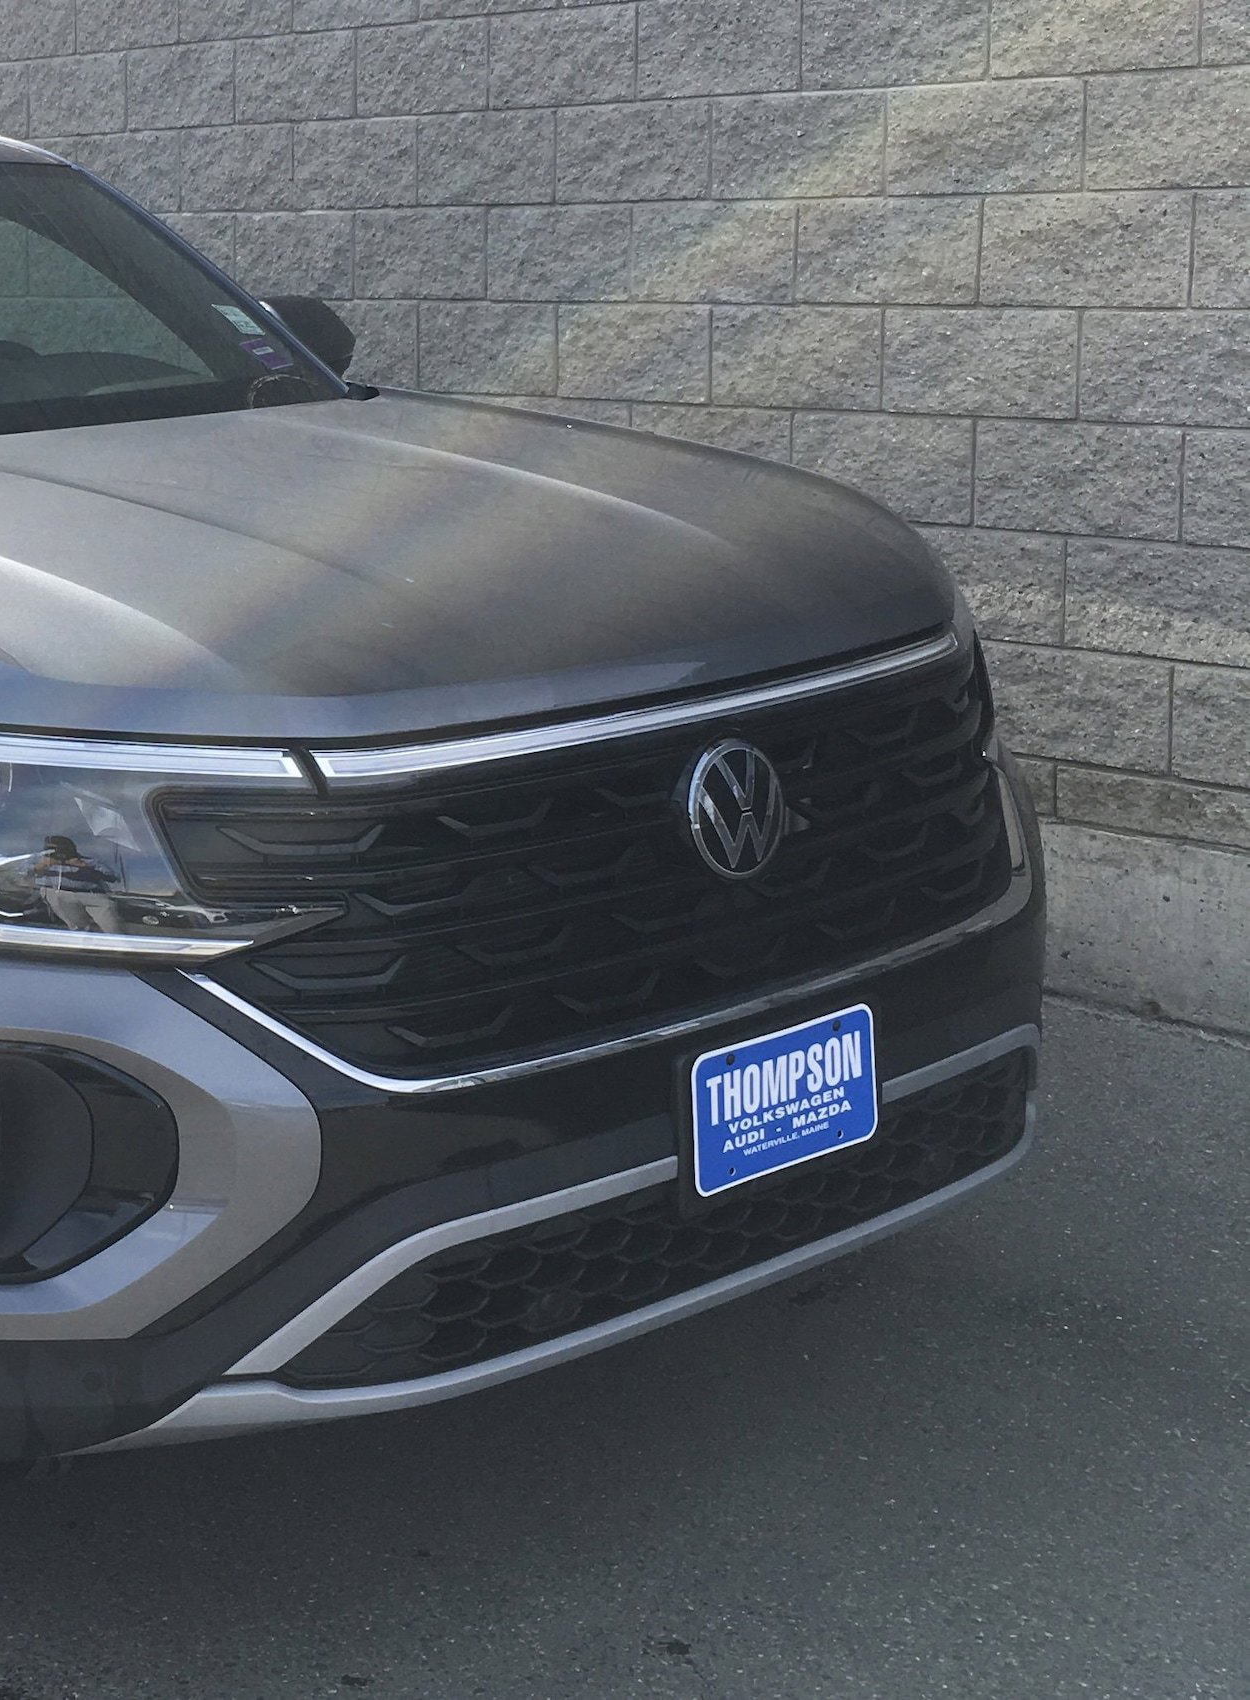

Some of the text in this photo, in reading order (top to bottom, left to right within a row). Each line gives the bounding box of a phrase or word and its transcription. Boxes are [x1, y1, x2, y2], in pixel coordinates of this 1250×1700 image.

[706, 1030, 863, 1127] THOMPSON
[723, 1129, 765, 1153] AUDI
[792, 1100, 852, 1129] MAZDA
[728, 1086, 845, 1134] VOLKSWAGEN
[801, 1121, 830, 1137] MAINE
